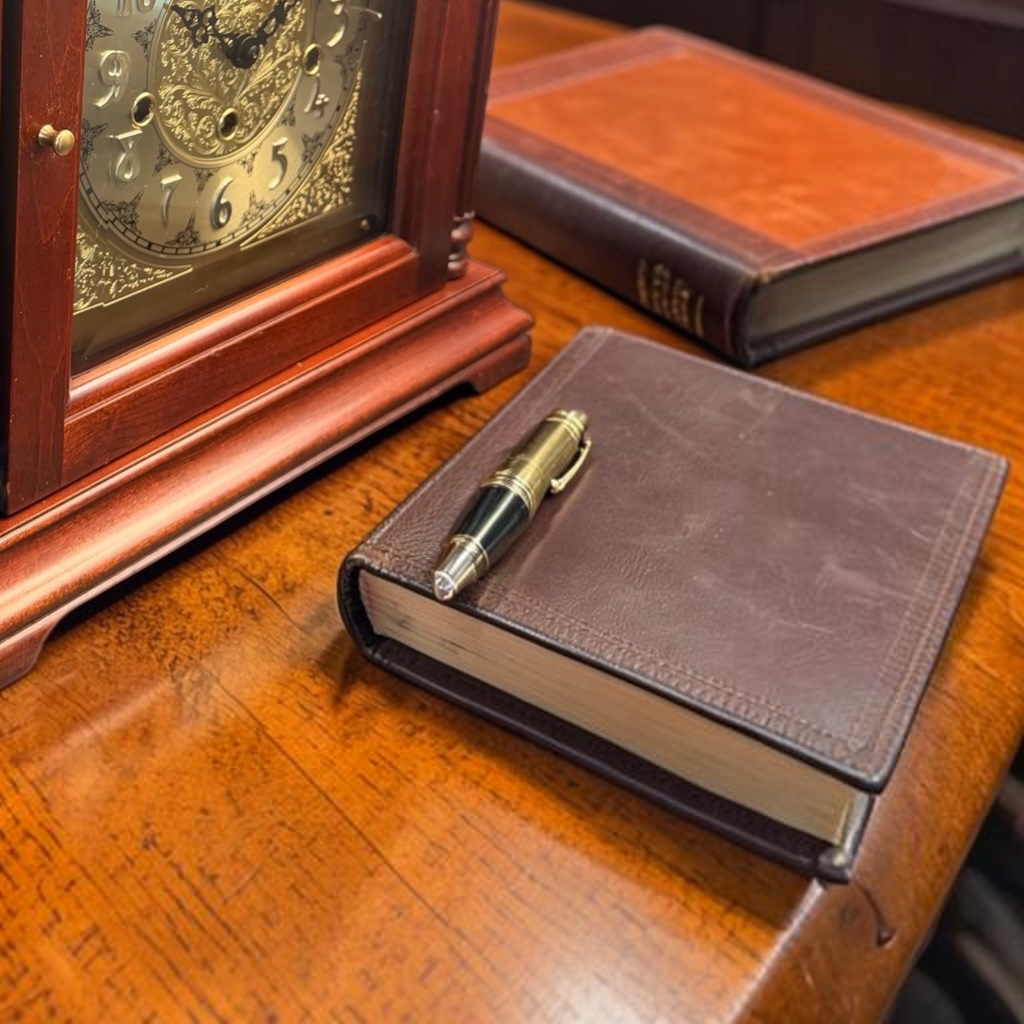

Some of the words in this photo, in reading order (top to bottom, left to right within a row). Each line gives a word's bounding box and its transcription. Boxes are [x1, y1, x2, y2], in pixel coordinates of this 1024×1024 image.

[93, 49, 130, 108] 9
[268, 136, 288, 190] 5
[160, 174, 182, 229] 7
[210, 176, 233, 230] 6
